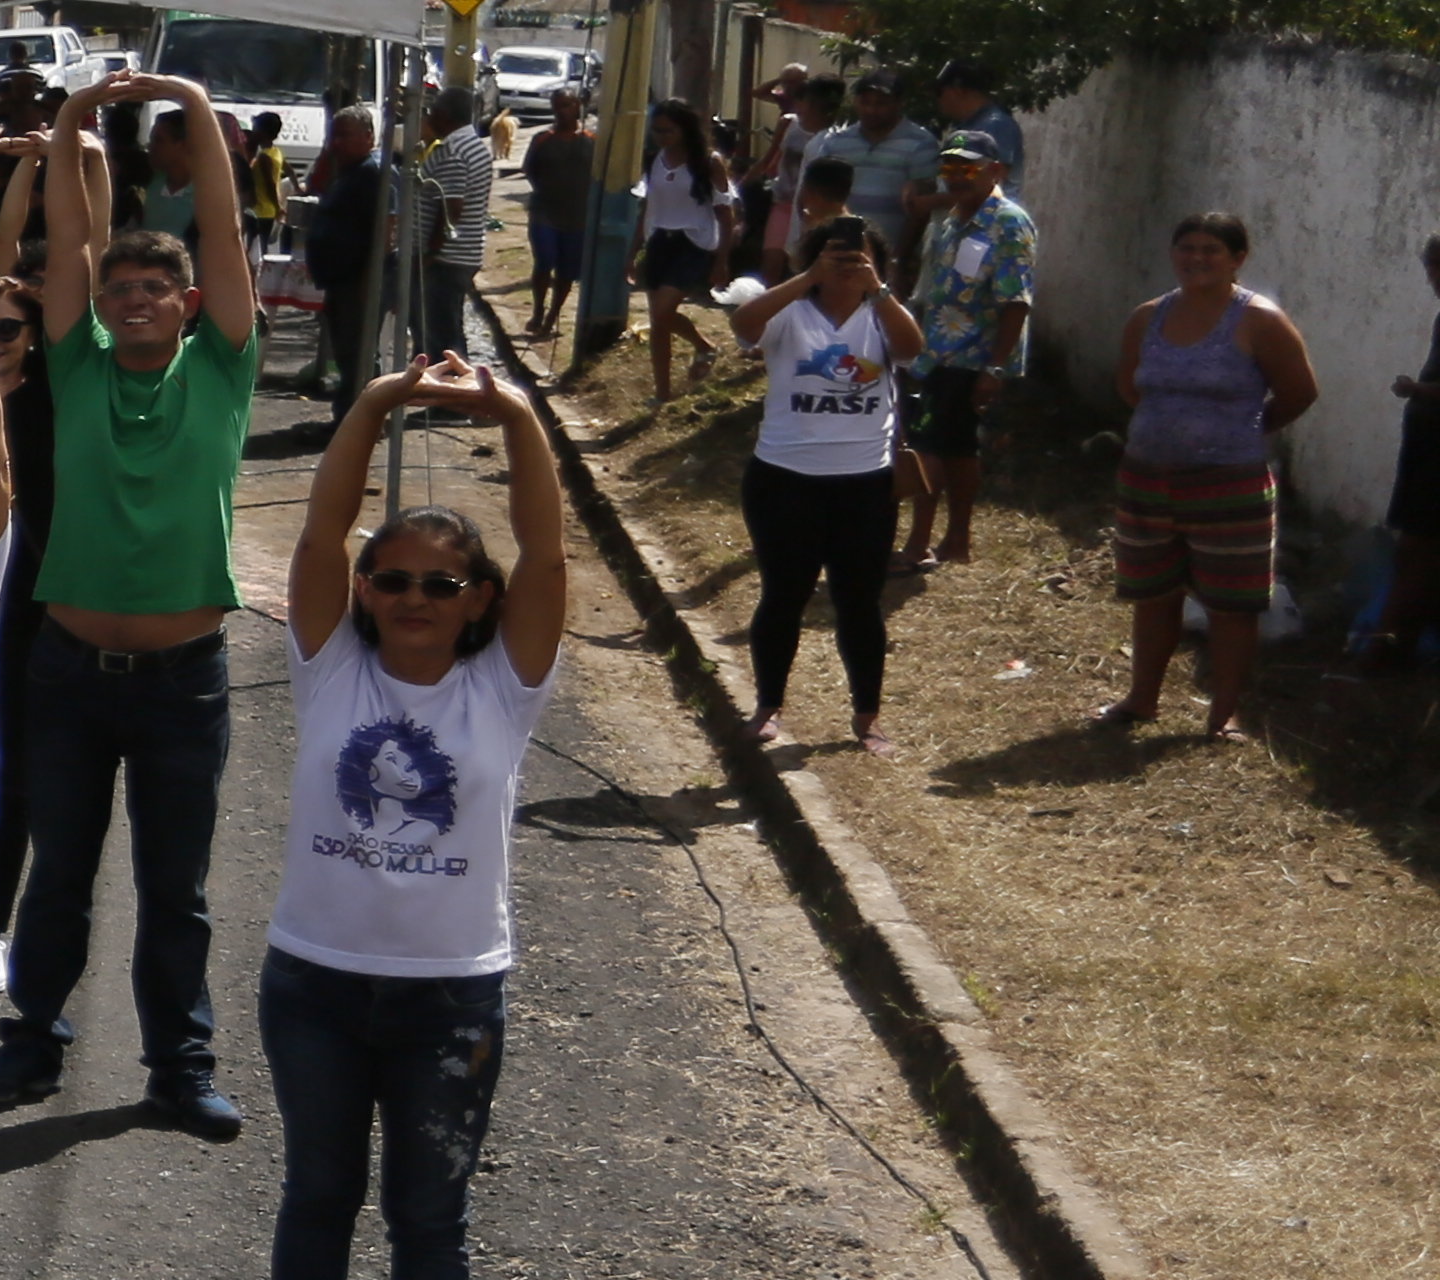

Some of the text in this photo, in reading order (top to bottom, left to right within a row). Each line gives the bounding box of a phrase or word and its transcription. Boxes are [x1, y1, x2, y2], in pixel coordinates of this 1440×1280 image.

[790, 392, 880, 415] NASF
[312, 834, 468, 876] ESPAÇO MULHER
[381, 840, 435, 856] PESSOA
